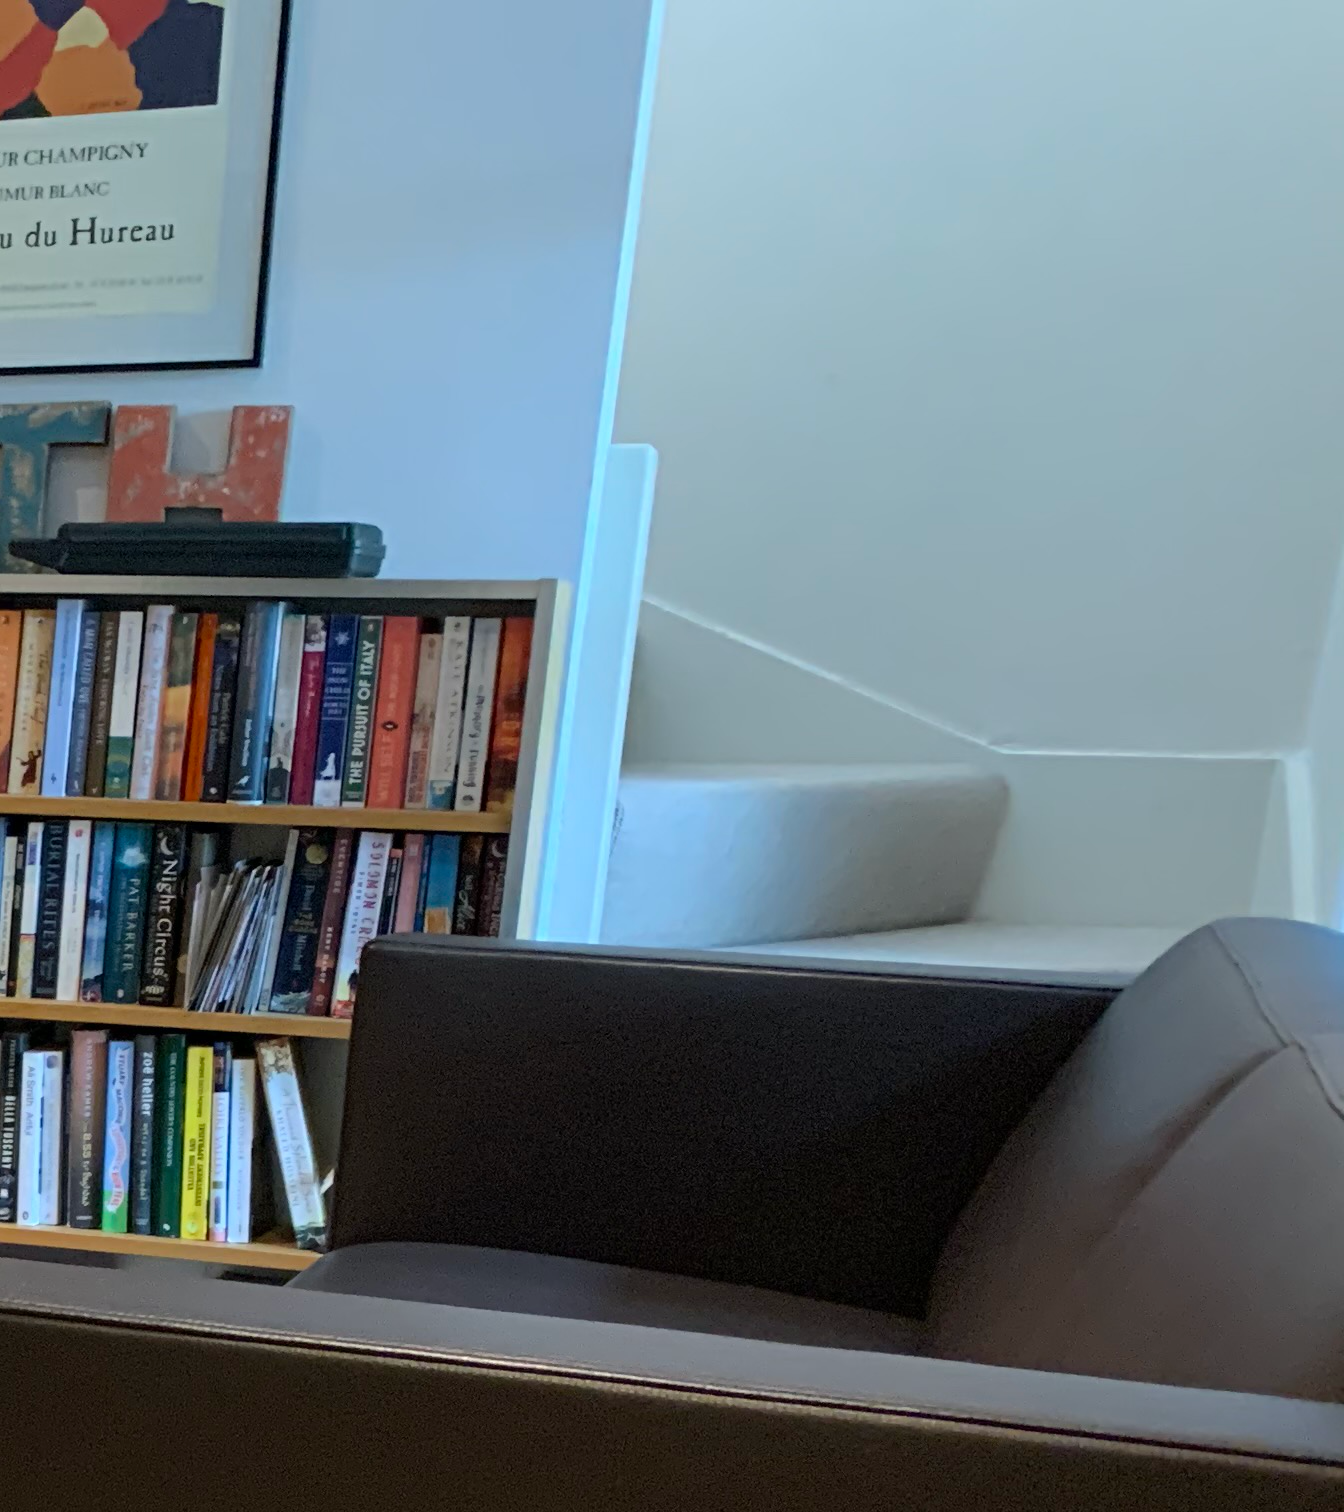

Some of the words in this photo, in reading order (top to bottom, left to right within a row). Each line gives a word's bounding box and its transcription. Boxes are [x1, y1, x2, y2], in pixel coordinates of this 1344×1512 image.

[23, 142, 150, 167] CHAMPIGNY
[48, 181, 111, 200] BLANC
[24, 221, 58, 250] du
[69, 216, 176, 247] Hureau
[83, 629, 94, 649] MAN
[360, 640, 375, 676] ITALY
[452, 640, 464, 680] KATE
[357, 680, 371, 700] OF
[351, 704, 369, 756] PURSUIT
[444, 690, 460, 773] ATKINSON
[349, 761, 364, 784] THE
[463, 749, 479, 788] running
[45, 825, 64, 893] BURIAL
[332, 839, 348, 894] EVENTIDE
[362, 842, 384, 909] SOLOMON
[128, 878, 141, 905] PAT
[156, 859, 179, 914] Night
[356, 872, 365, 900] SIMON
[42, 898, 57, 949] RITES
[456, 890, 475, 931] Alice
[122, 912, 138, 972] BARKER
[153, 918, 172, 976] Circus
[325, 927, 333, 950] KENT
[27, 1066, 36, 1077] Ali
[142, 1052, 153, 1074] zoë
[4, 1095, 17, 1123] BELLA
[26, 1080, 35, 1106] Smith
[84, 1084, 92, 1117] EAMES
[115, 1089, 125, 1125] MACONIE
[141, 1078, 153, 1116] heller
[25, 1112, 34, 1136] Artful
[1, 1127, 15, 1169] TUSCANY
[82, 1133, 92, 1159] 8.55
[214, 1135, 223, 1177] VALLEY
